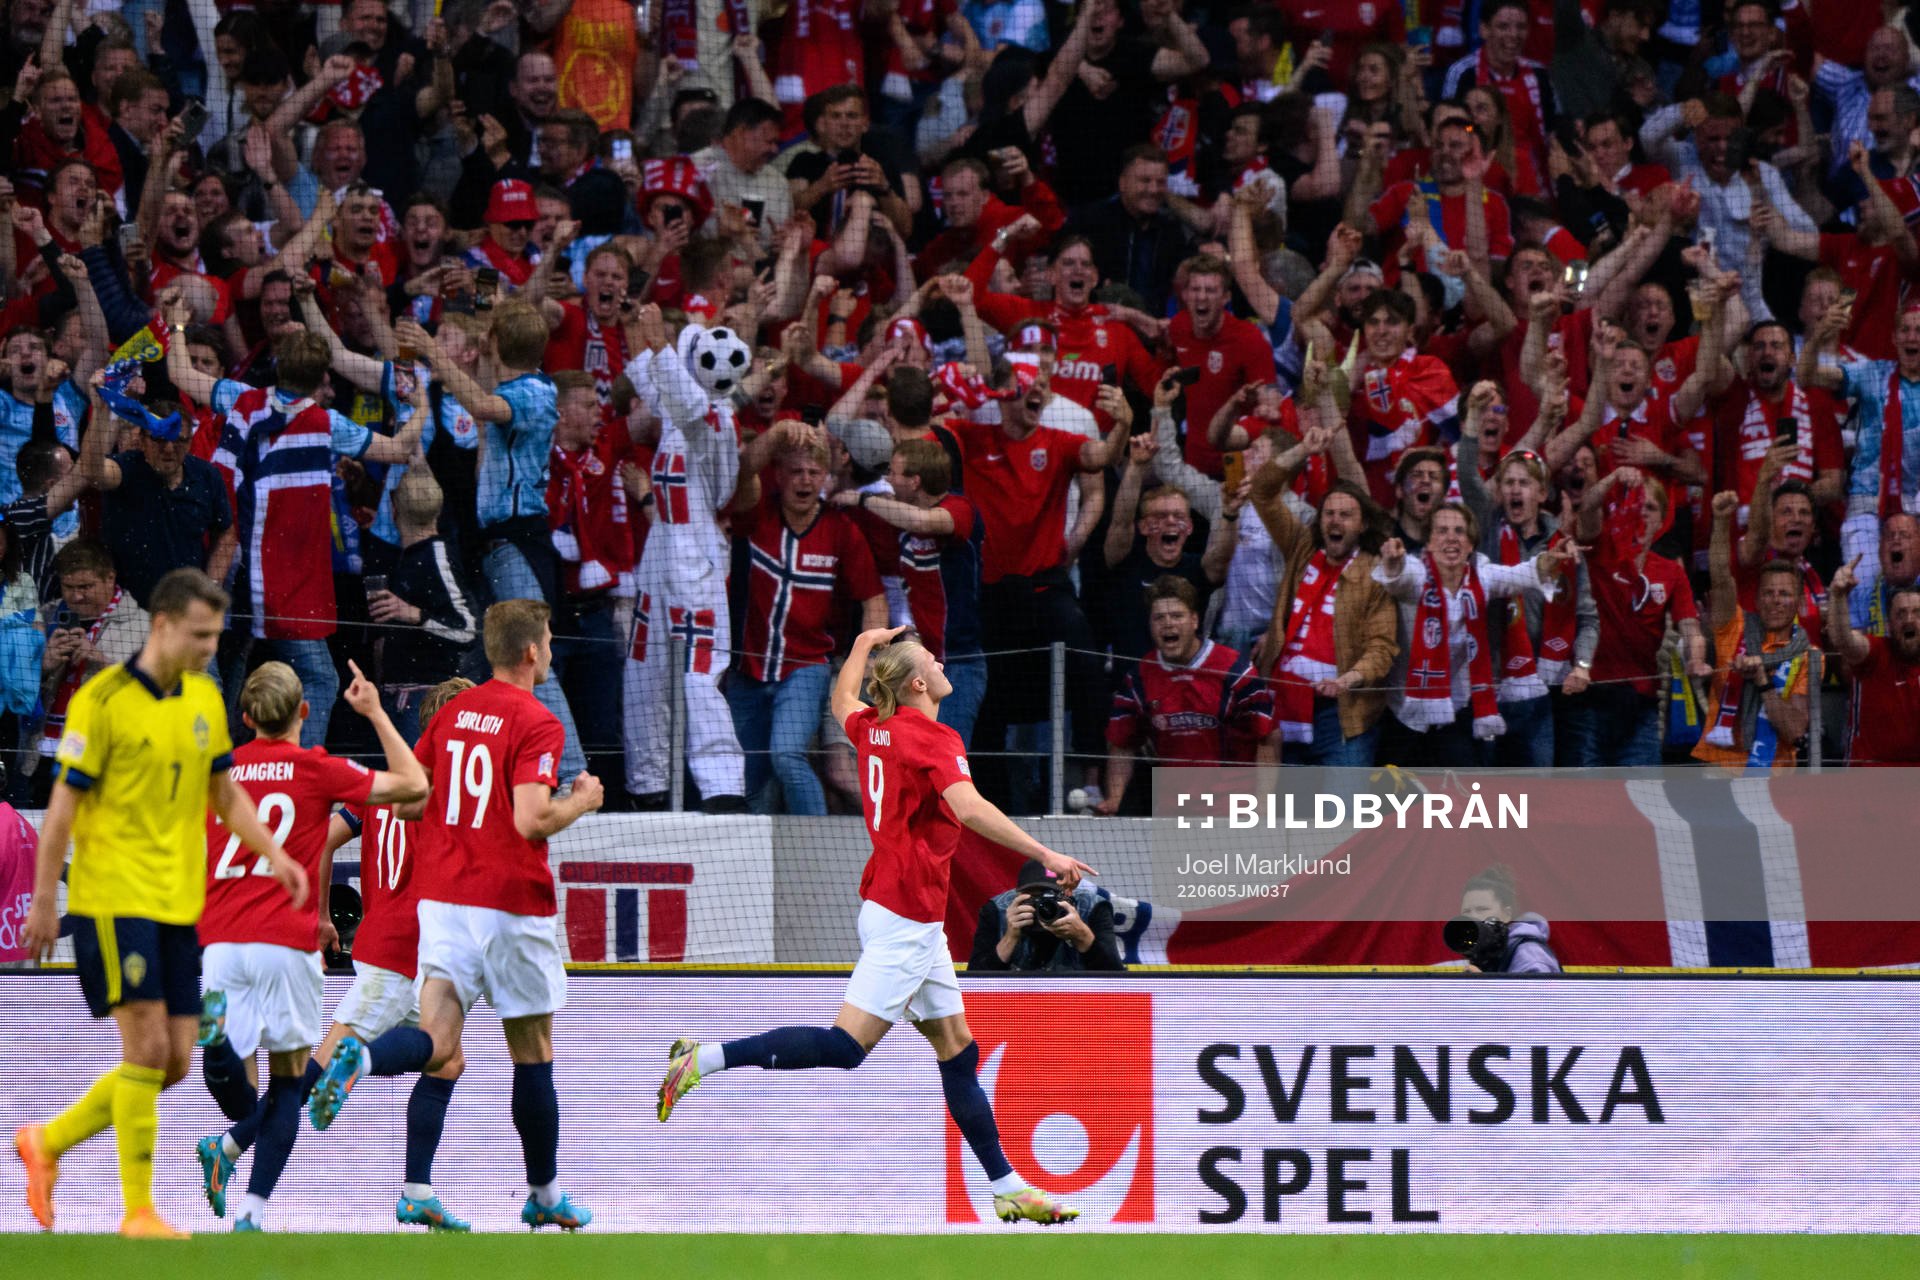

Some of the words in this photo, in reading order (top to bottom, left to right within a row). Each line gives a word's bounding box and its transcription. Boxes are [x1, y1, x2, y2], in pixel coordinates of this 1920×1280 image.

[454, 710, 504, 735] SØRLOTH
[171, 761, 181, 801] 7
[445, 739, 493, 829] 19
[868, 755, 885, 832] 9
[376, 808, 406, 891] 10
[1196, 1043, 1666, 1124] SVENSKA
[1197, 1146, 1439, 1223] SPEL
